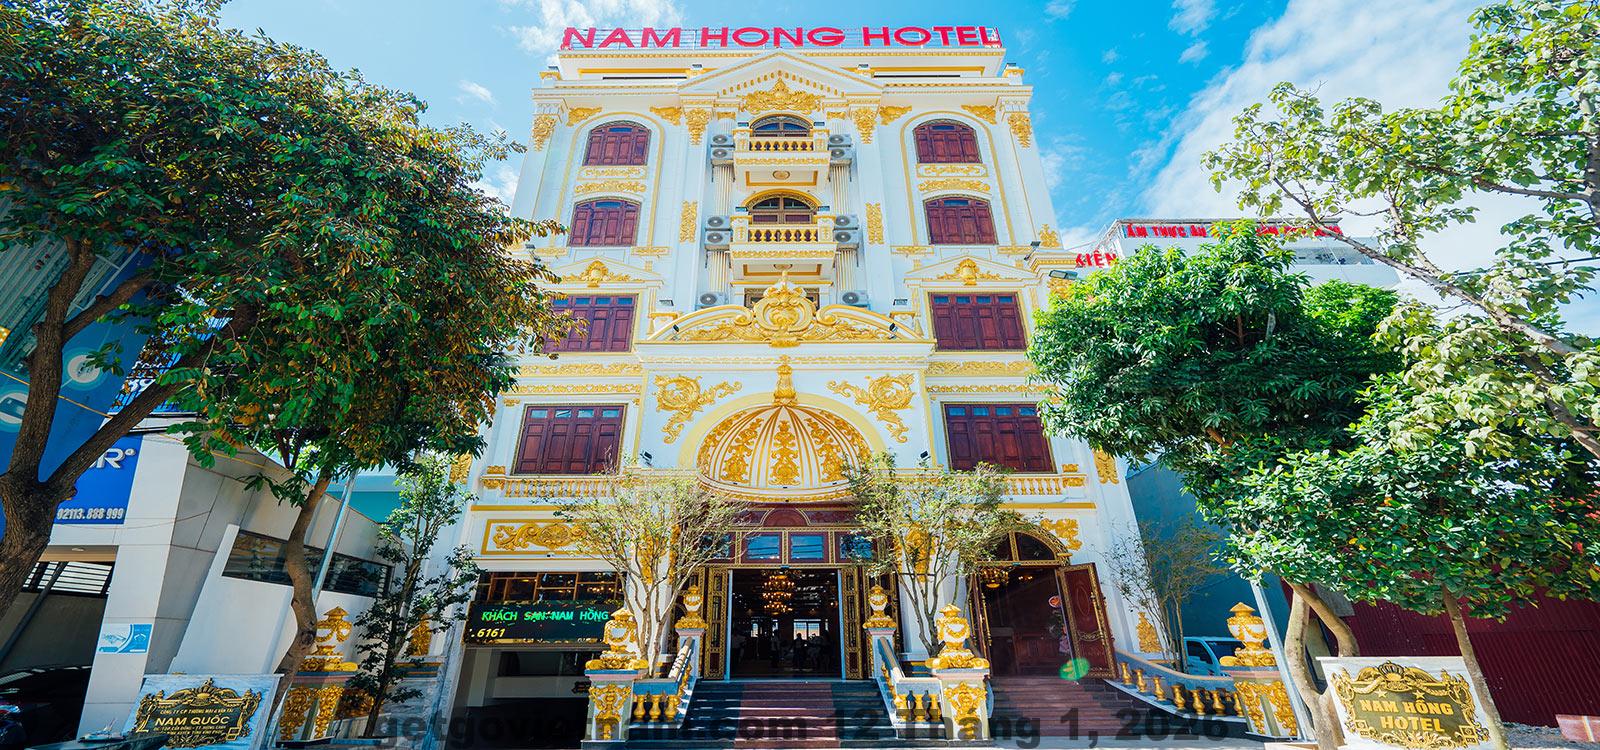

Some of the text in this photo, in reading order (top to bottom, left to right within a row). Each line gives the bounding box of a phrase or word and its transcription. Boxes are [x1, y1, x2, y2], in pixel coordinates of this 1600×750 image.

[561, 26, 1001, 49] NAM HONG HOTEL
[481, 609, 518, 621] KHÁCH
[551, 611, 574, 621] NAM
[1359, 700, 1399, 713] NAM
[155, 713, 230, 726] NAM QUỐC
[1380, 716, 1445, 732] HOTEL
